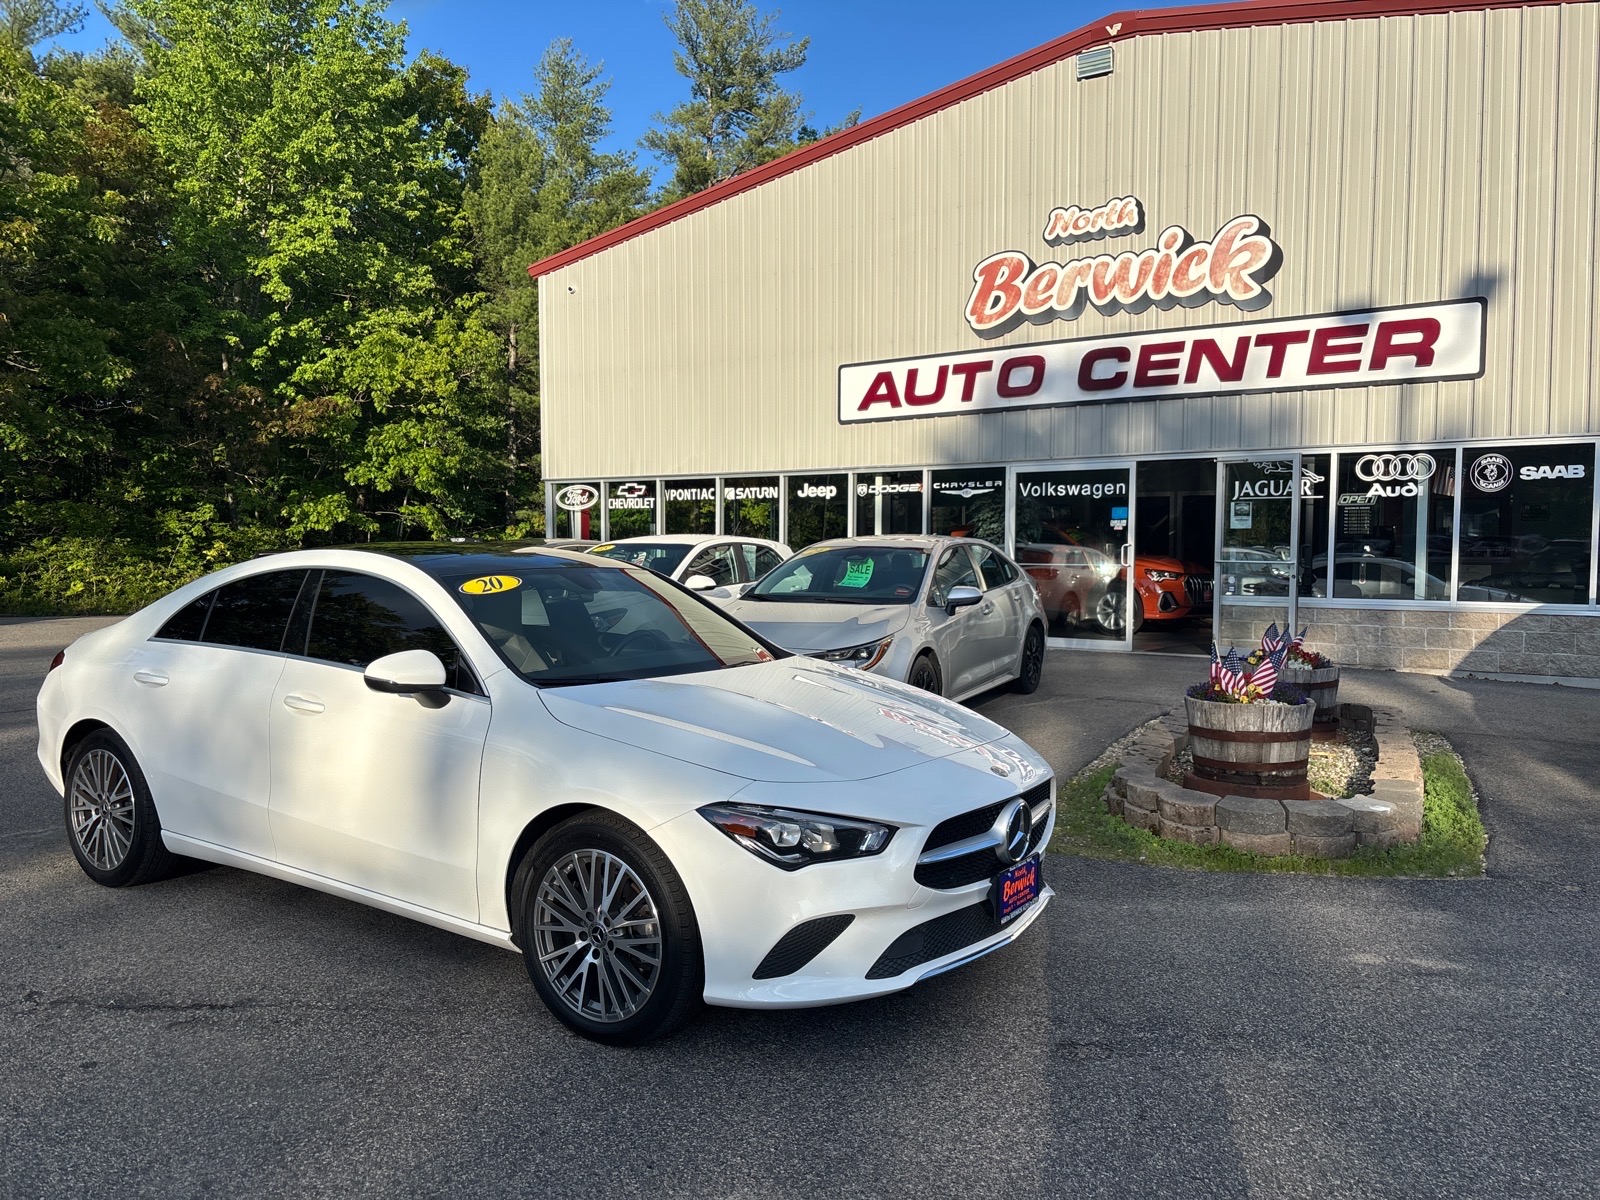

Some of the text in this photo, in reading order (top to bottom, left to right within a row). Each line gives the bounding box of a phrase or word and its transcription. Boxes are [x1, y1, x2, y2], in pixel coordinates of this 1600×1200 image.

[1047, 198, 1141, 242] North
[966, 217, 1271, 333] Berwick
[857, 317, 1441, 411] AUTO CENTER
[1480, 456, 1503, 466] SAAB
[1519, 464, 1586, 480] SAAB
[797, 483, 837, 500] Jeep
[868, 484, 920, 494] DODGE
[933, 480, 1003, 489] CHRYSLER
[1020, 481, 1126, 499] Volkswagen
[1232, 480, 1312, 500] JAGUAR
[1366, 482, 1424, 498] Audi
[1479, 479, 1505, 489] SCANIA
[565, 488, 589, 506] Ford
[670, 488, 715, 501] PONTIAC
[736, 486, 778, 499] SATURN
[1340, 495, 1376, 504] OPEN
[608, 498, 655, 509] CHEVROLET
[849, 564, 871, 575] SALE
[475, 576, 503, 593] 20
